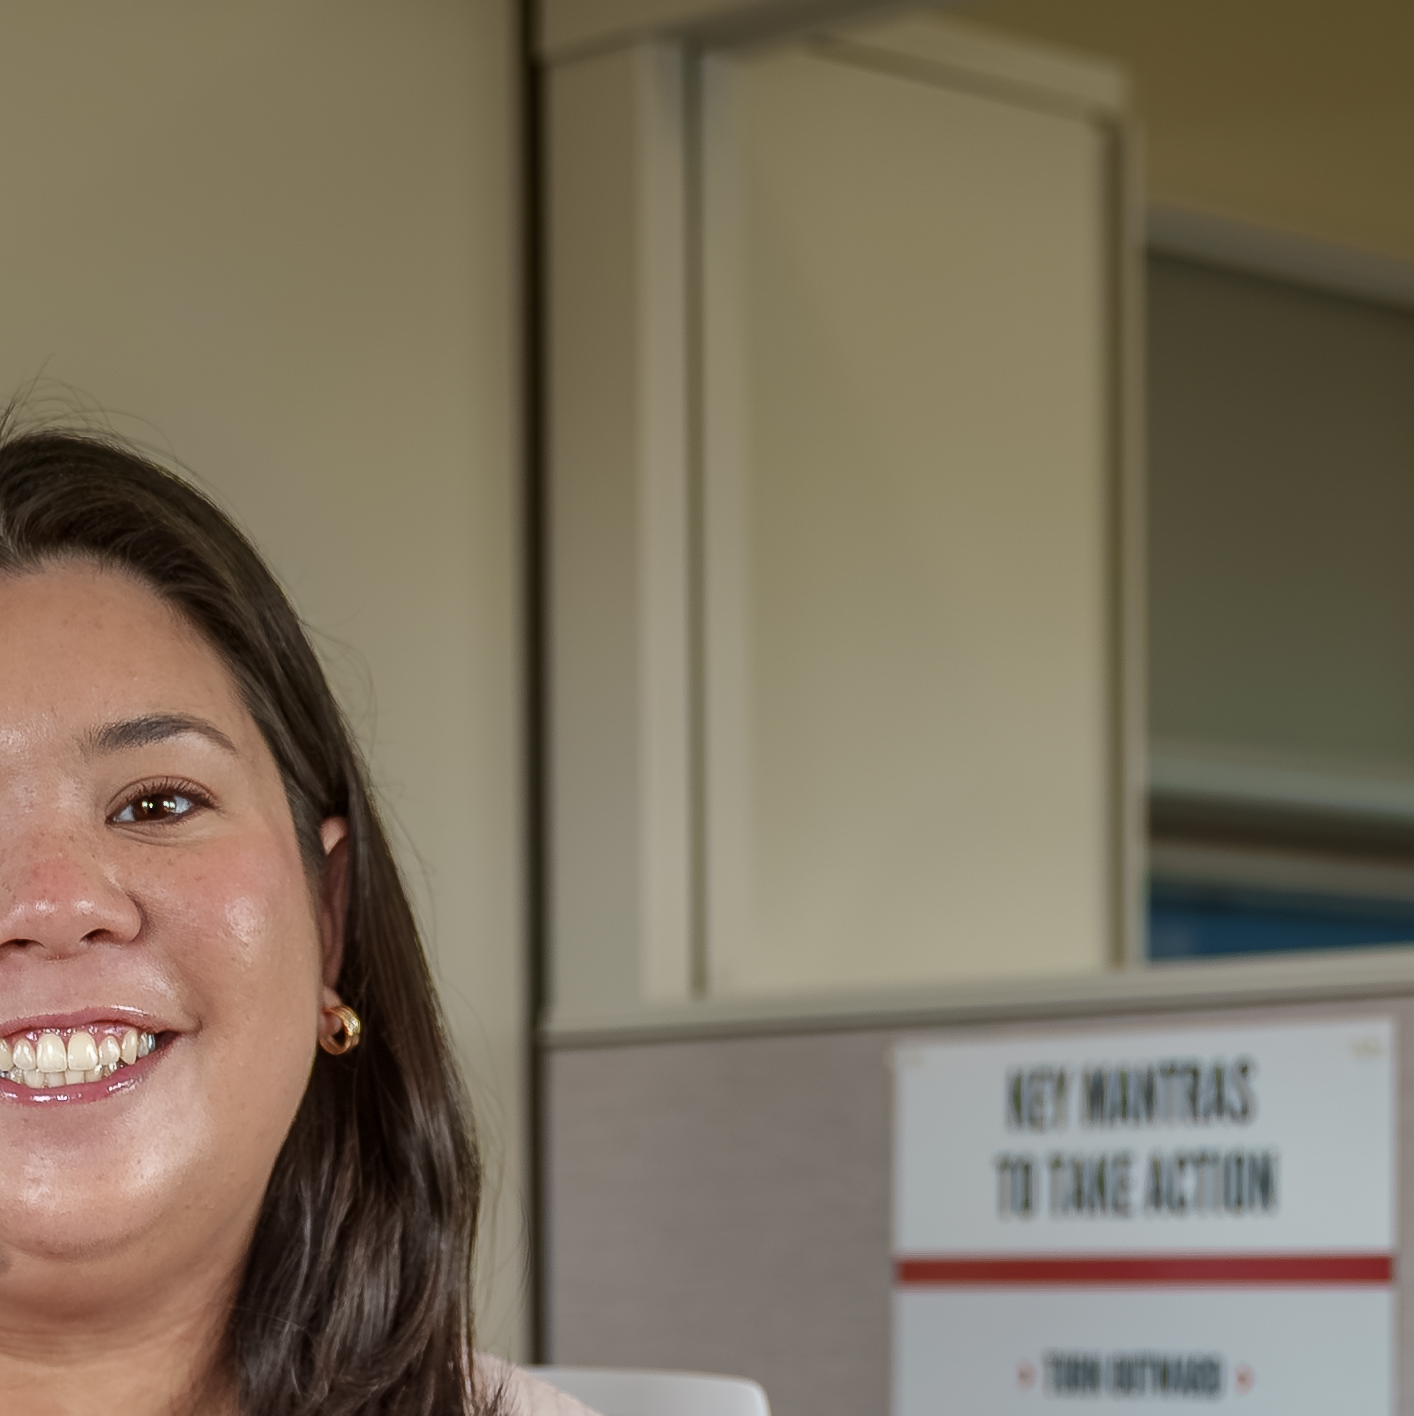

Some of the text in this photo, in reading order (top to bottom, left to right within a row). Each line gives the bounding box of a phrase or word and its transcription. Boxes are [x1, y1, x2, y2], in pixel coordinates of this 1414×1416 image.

[1006, 1057, 1256, 1131] KEY MANTRAS
[995, 1147, 1279, 1220] TO TAKE ACTION
[1044, 1350, 1226, 1400] TURN OUTWARD
